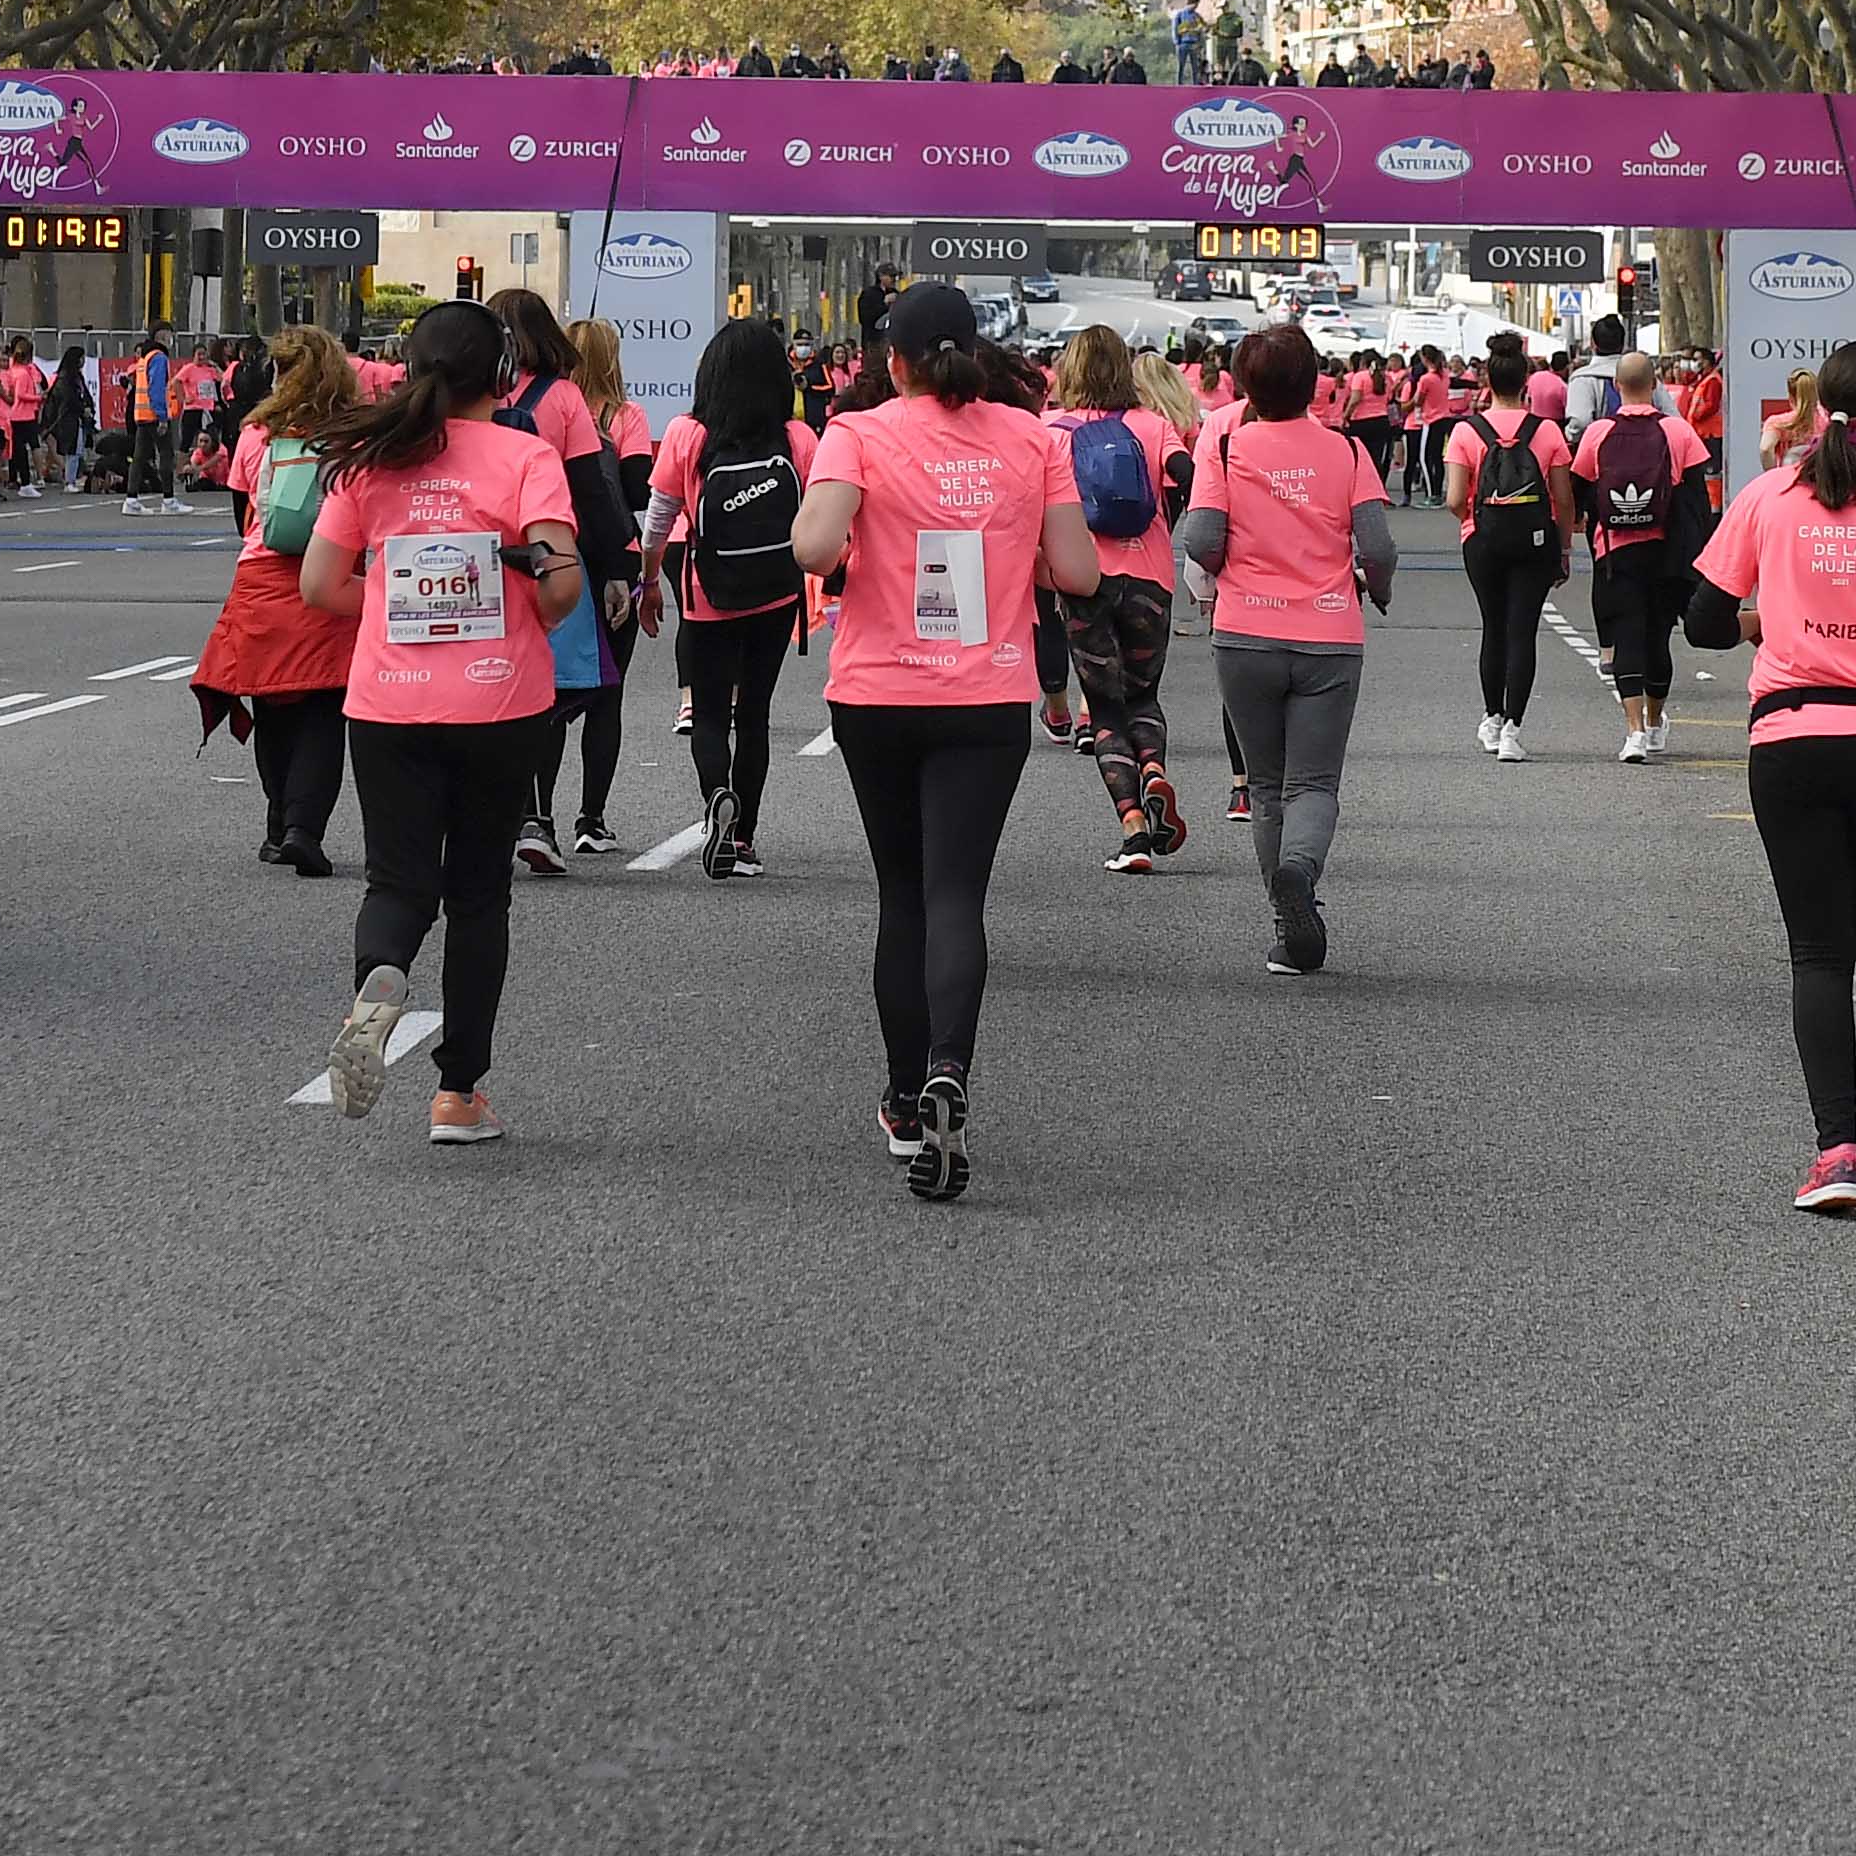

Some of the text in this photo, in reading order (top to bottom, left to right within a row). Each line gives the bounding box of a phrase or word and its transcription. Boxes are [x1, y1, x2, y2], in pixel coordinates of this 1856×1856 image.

[1181, 116, 1277, 137] ASTURIANA
[160, 135, 241, 153] ASTURIANA
[279, 136, 366, 156] OYSHO
[396, 143, 479, 159] Santander
[544, 142, 617, 157] ZURICH
[663, 147, 747, 162] Santander
[820, 146, 892, 162] ZURICH
[922, 146, 1011, 166] OYSHO
[1041, 148, 1122, 166] ASTURIANA
[1162, 145, 1255, 173] Carrera
[1384, 152, 1465, 171] ASTURIANA
[1503, 154, 1592, 174] OYSHO
[1622, 161, 1708, 177] Santander
[1774, 160, 1847, 175] ZURICH
[1184, 171, 1290, 217] de la Mujer
[264, 228, 361, 249] OYSHO
[931, 238, 1028, 260] OYSHO
[1487, 246, 1586, 268] OYSHO
[604, 250, 685, 268] ASTURIANA
[1758, 271, 1846, 290] ASTURIANA
[616, 319, 691, 340] YSHO
[625, 383, 692, 398] ZURICH
[923, 458, 1002, 474] CARRERA
[941, 476, 989, 489] DE LA
[412, 494, 459, 505] DE LA
[723, 478, 778, 511] adidas
[939, 492, 993, 506] MUJER
[409, 508, 463, 521] MUJER
[1609, 513, 1653, 524] adidas
[1814, 544, 1837, 555] DE
